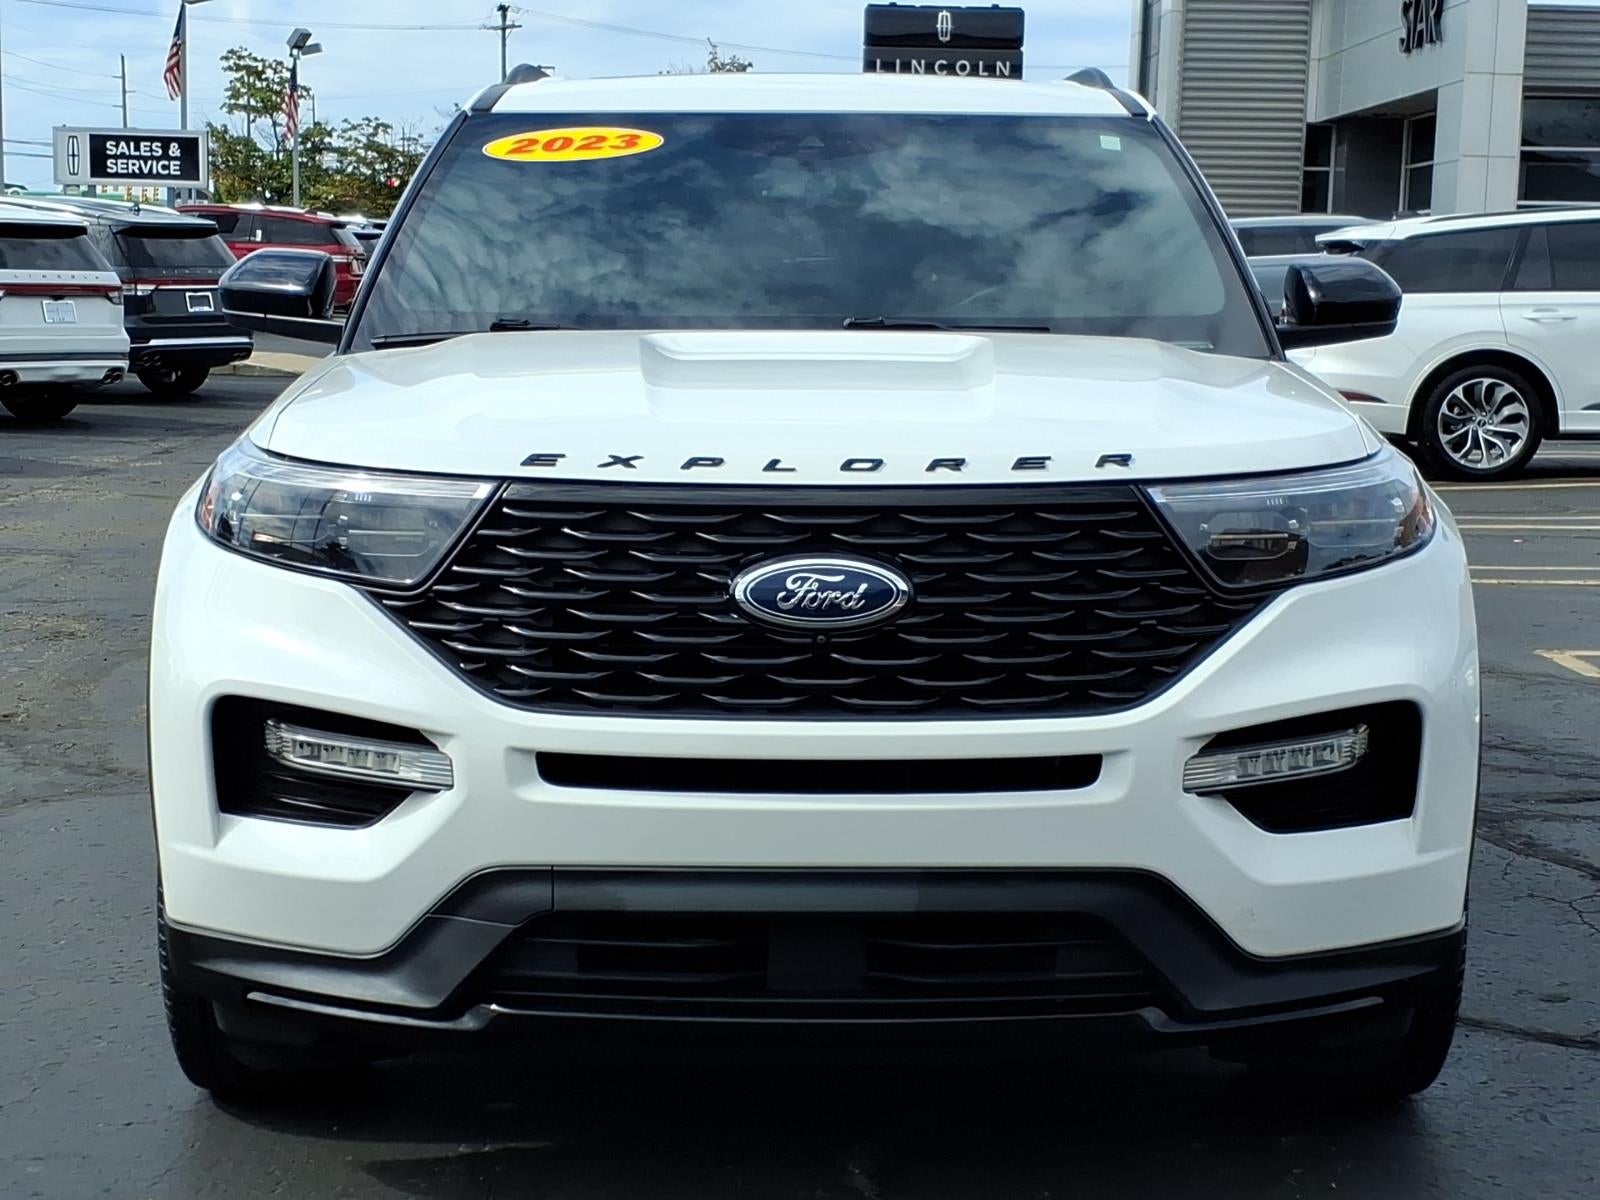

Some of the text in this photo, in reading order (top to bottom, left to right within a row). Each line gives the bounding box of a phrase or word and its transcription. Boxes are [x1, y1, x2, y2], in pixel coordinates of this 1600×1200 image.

[876, 58, 1011, 76] LINCOLN
[106, 141, 181, 157] SALES &
[505, 134, 641, 154] 2023
[106, 159, 181, 175] SERVICE
[520, 453, 1133, 472] EXPLORER
[776, 572, 868, 609] Ford
